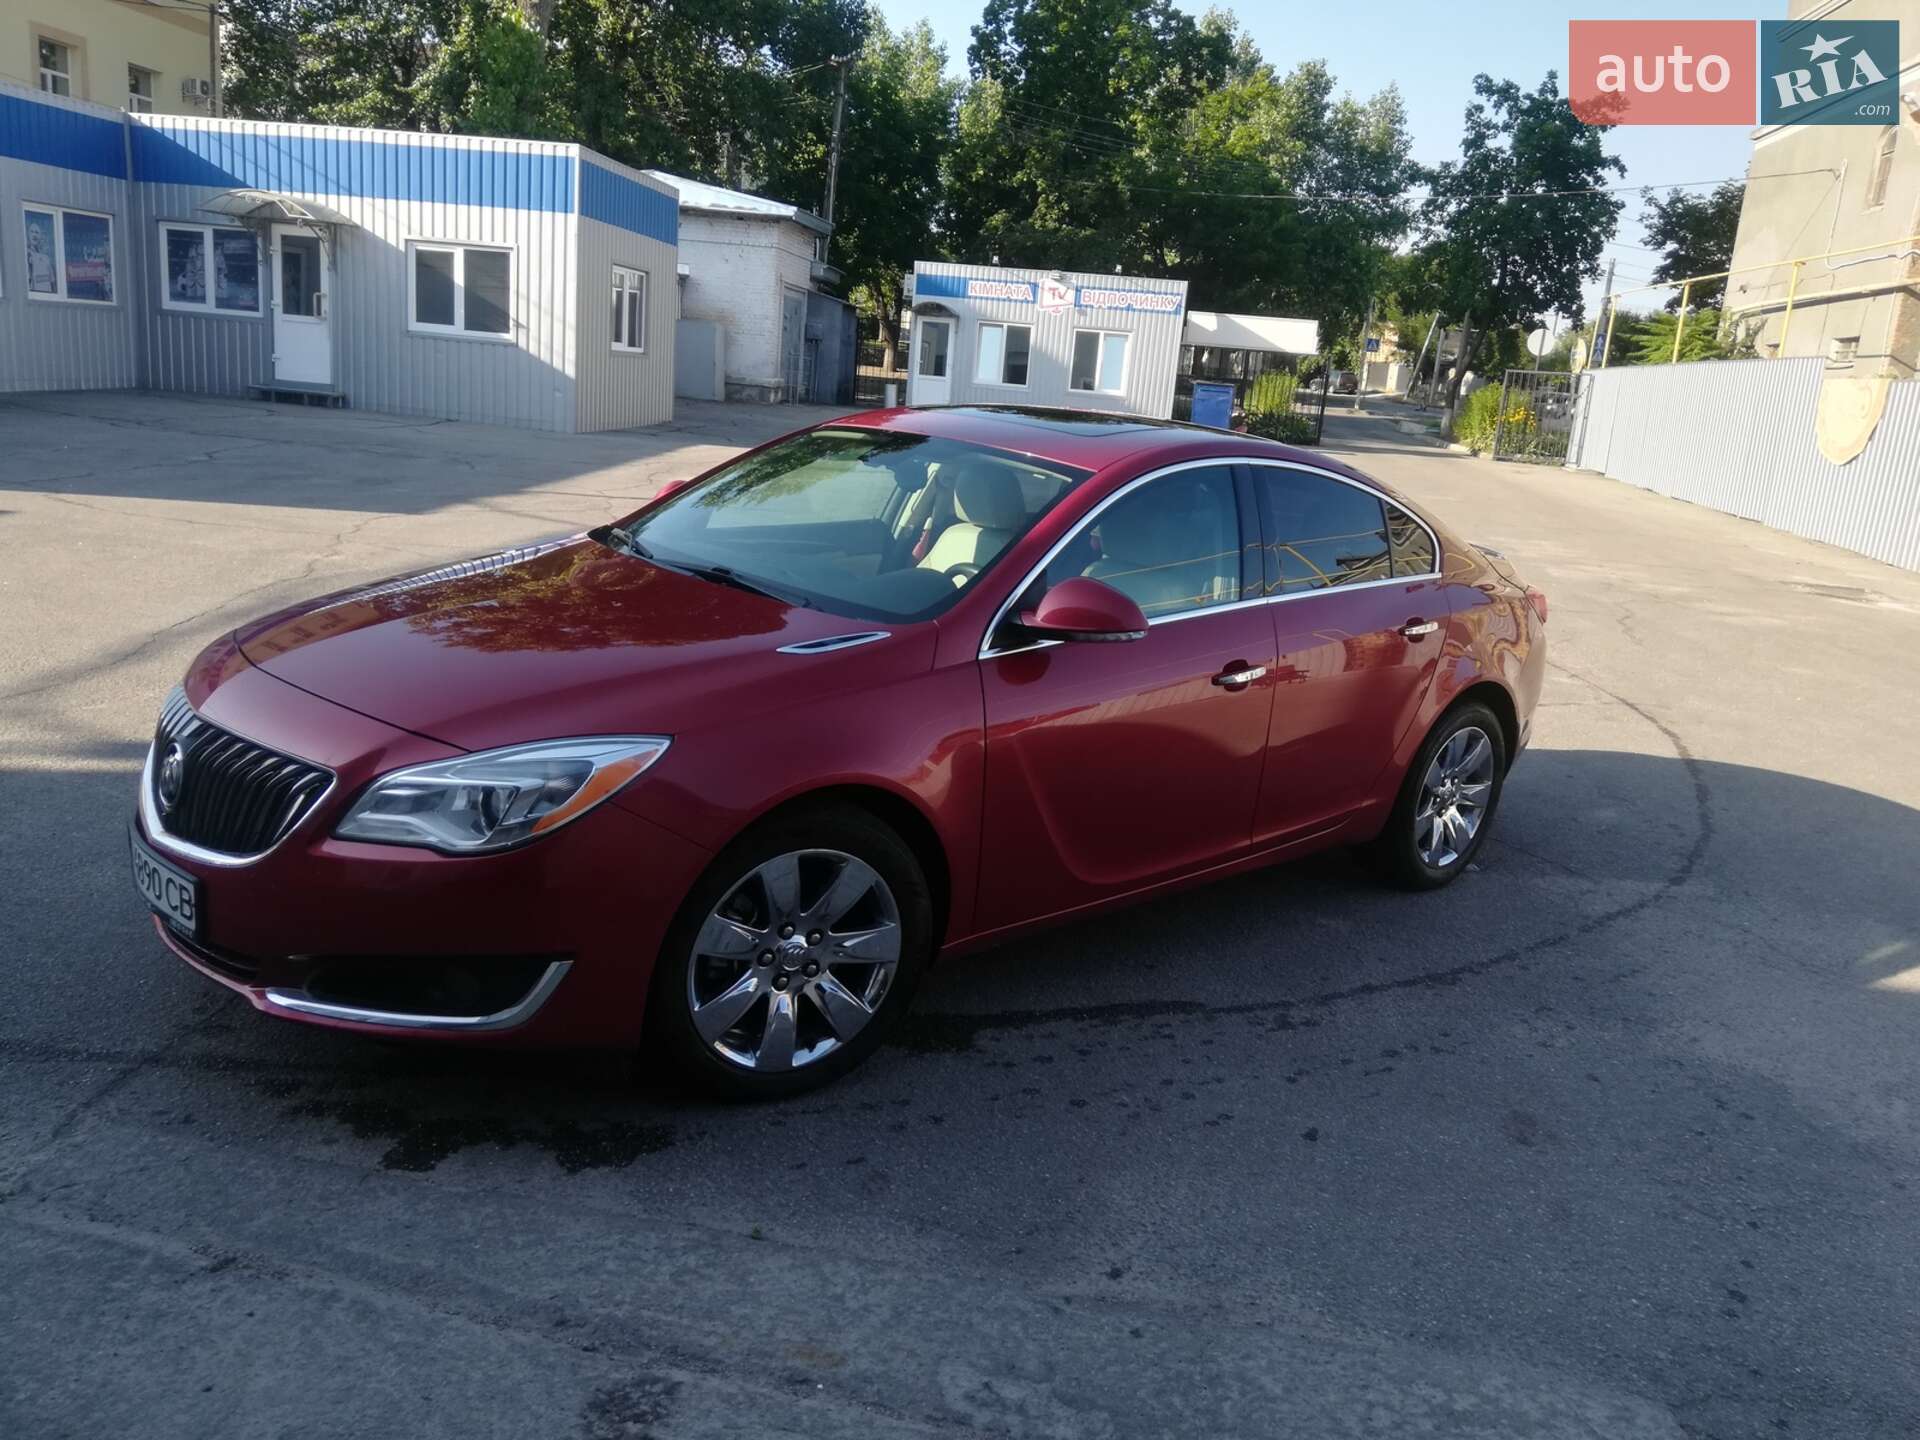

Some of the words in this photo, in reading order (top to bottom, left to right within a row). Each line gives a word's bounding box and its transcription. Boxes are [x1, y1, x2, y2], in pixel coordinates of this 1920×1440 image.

[969, 282, 1032, 300] КІМНАТА
[1082, 290, 1180, 311] ВІДПОЧИНКУ
[165, 877, 194, 921] CB
